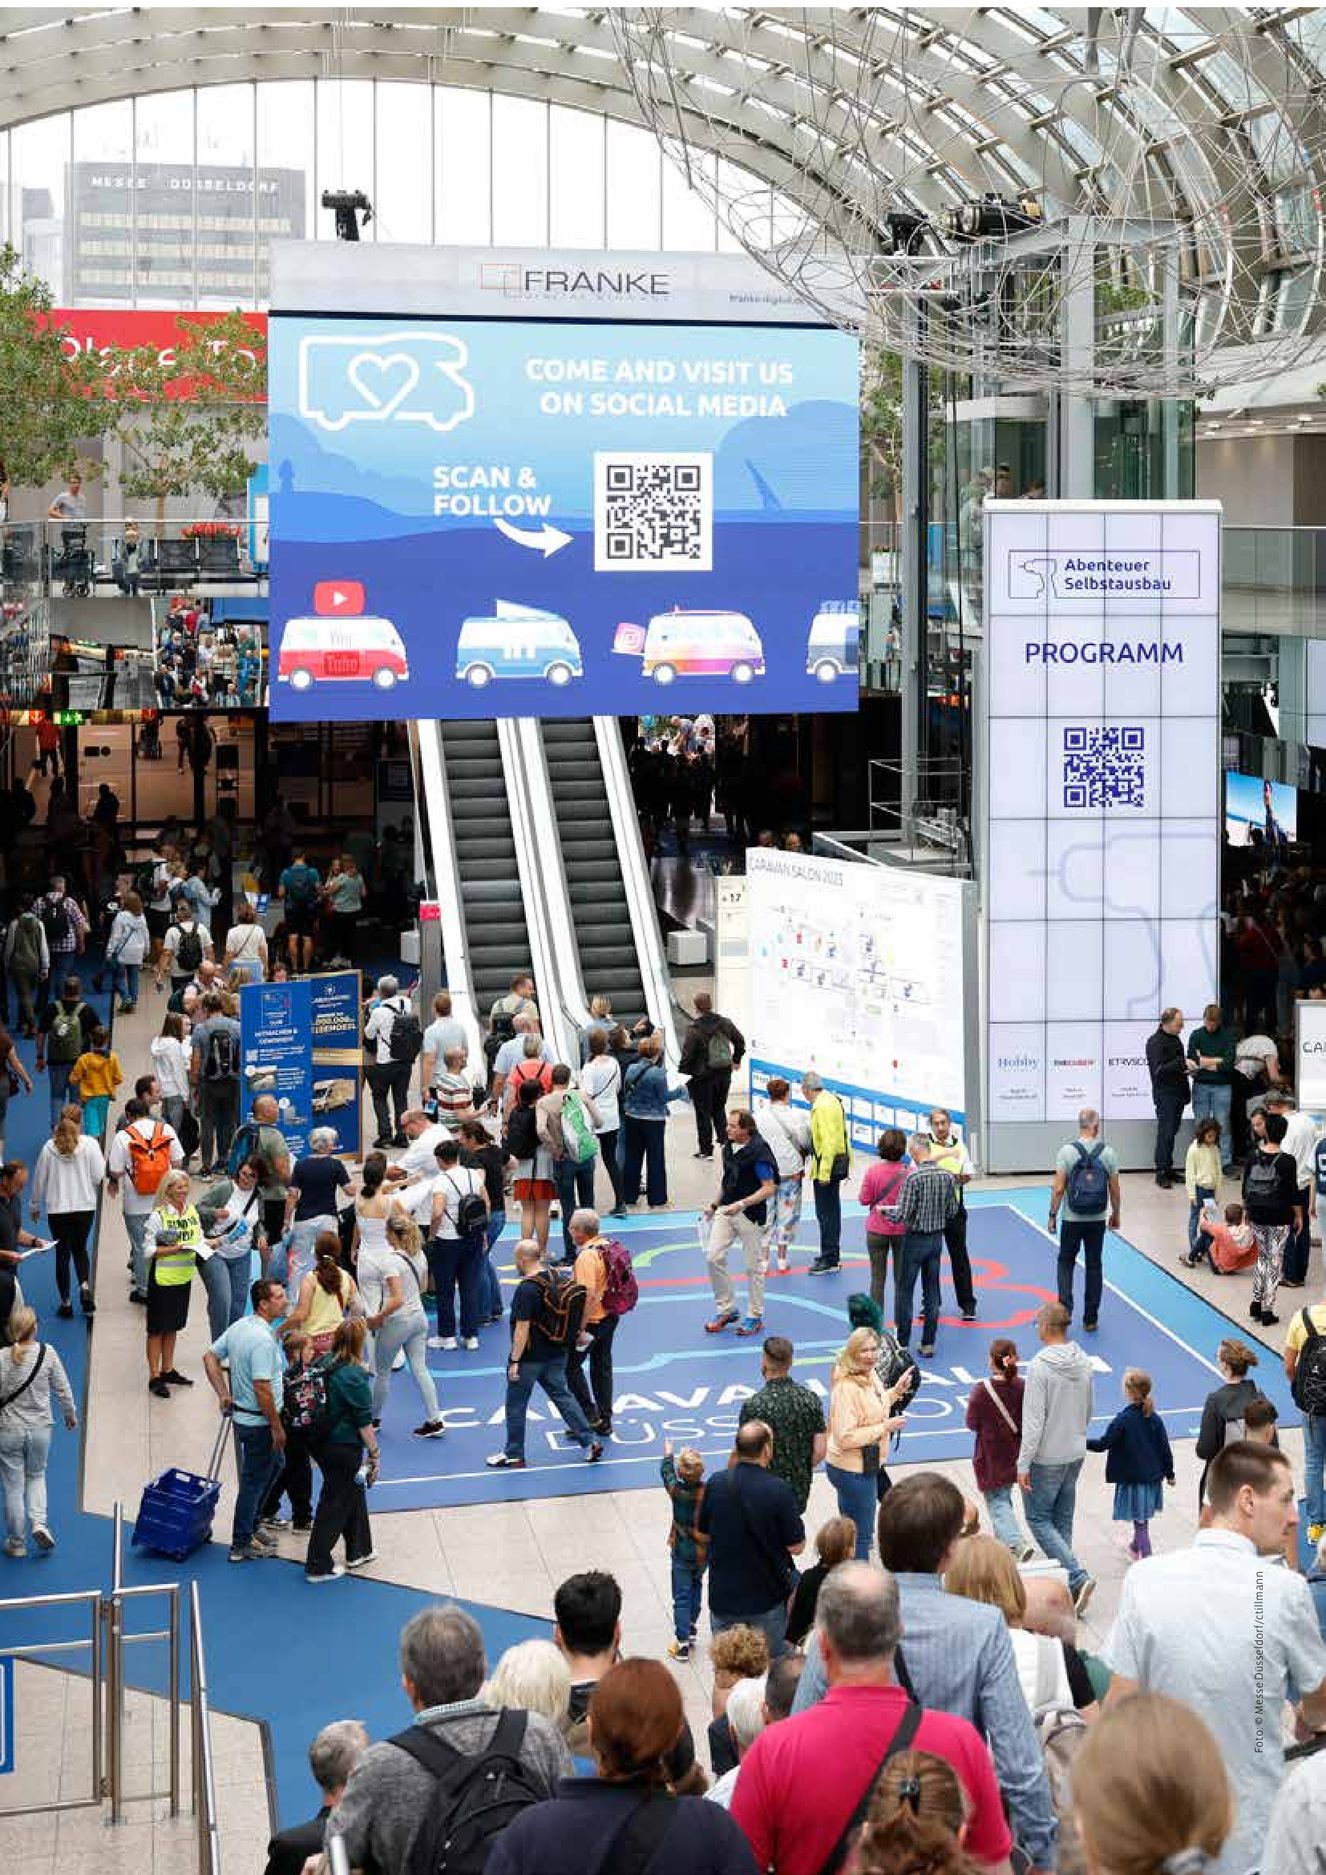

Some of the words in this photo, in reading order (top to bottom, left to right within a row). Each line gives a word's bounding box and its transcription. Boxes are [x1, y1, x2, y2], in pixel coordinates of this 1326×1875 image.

[525, 271, 671, 295] FRANKE
[526, 359, 608, 381] COME
[614, 361, 675, 383] AND
[682, 363, 754, 384] VISIT
[759, 364, 793, 385] US
[540, 393, 583, 416] ON
[590, 393, 691, 416] SOCIAL
[700, 395, 787, 417] MEDIA
[433, 466, 511, 488] SCAN
[517, 467, 537, 489] &
[433, 495, 551, 516] FOLLOW
[1065, 559, 1150, 571] Abenteuer
[1065, 577, 1171, 590] Selbstausbau
[1025, 642, 1184, 664] PROGRAMM
